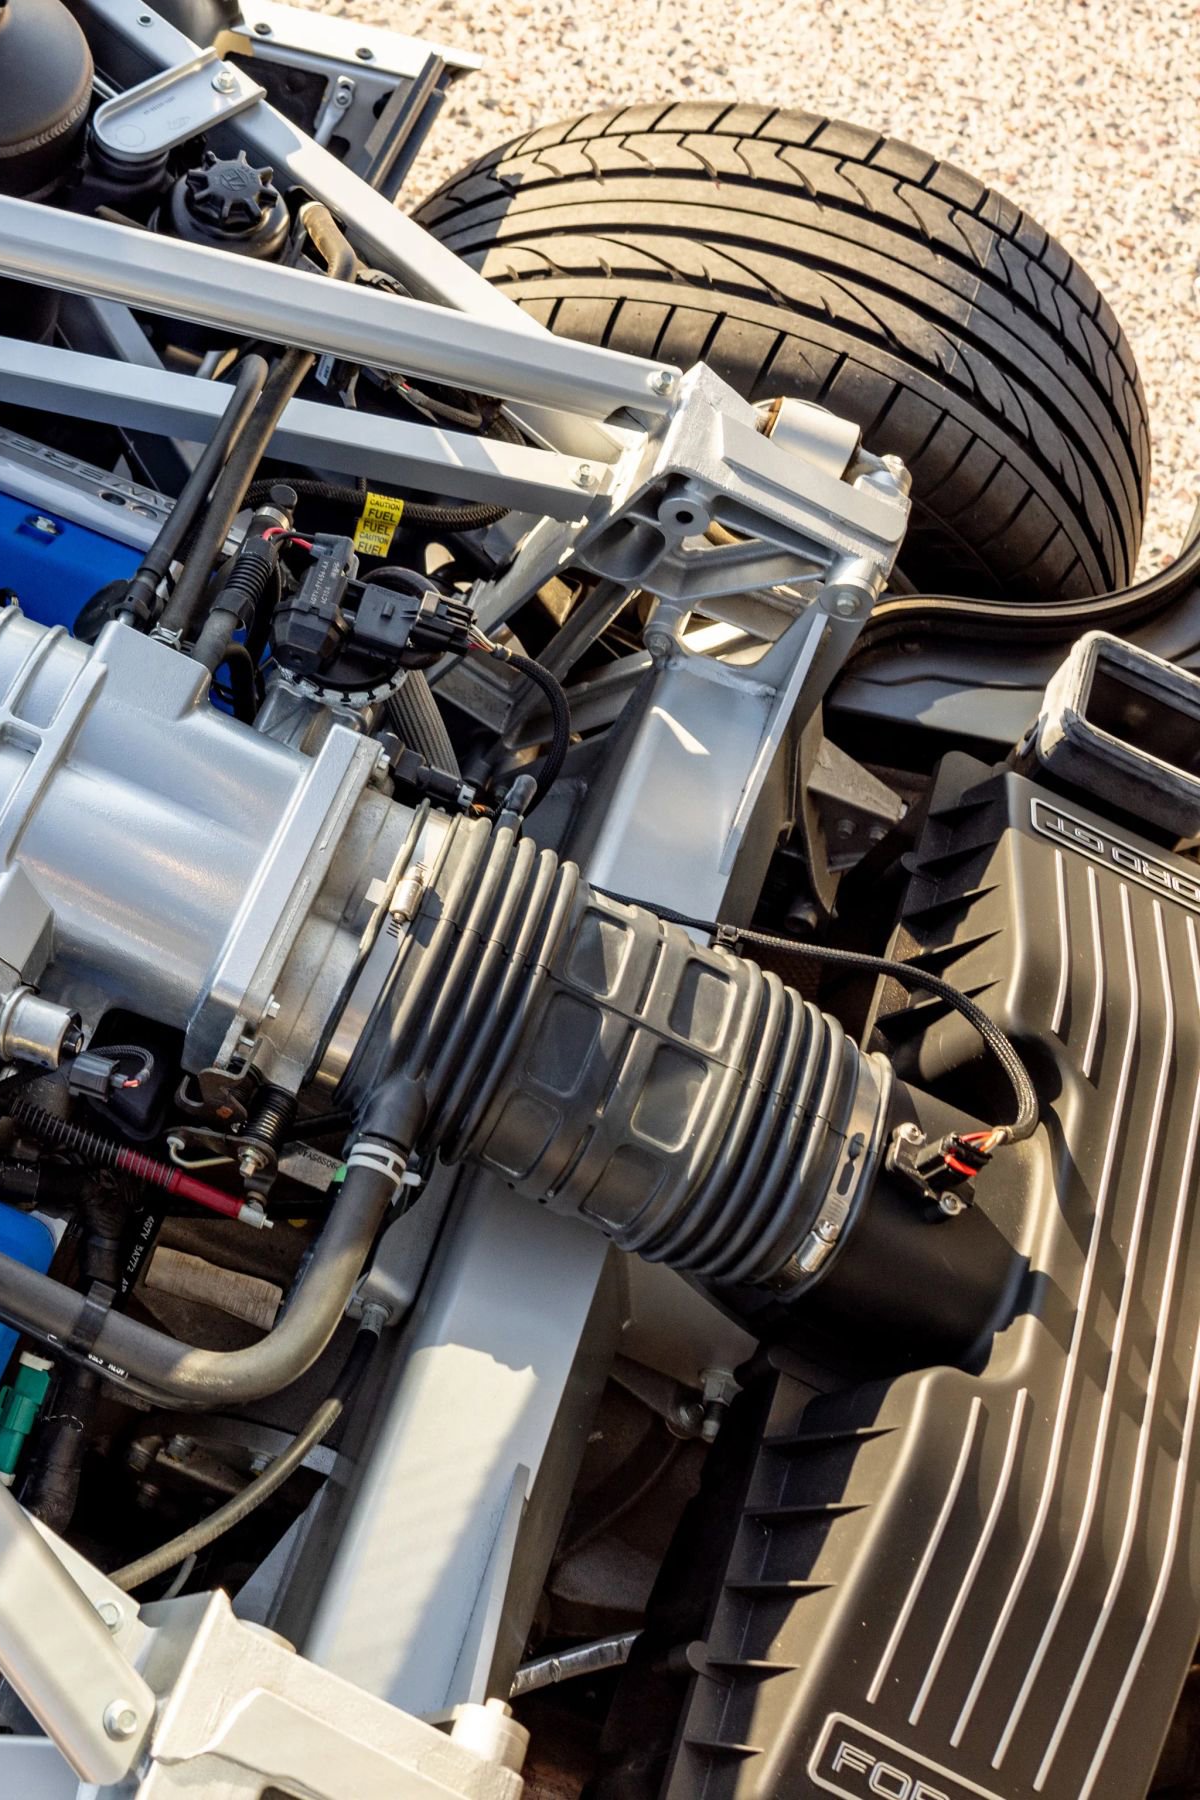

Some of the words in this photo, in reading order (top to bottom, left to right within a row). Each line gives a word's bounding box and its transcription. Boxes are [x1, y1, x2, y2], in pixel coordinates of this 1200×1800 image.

[370, 500, 401, 511] CAUTION
[368, 509, 396, 522] FUEL
[364, 520, 390, 536] FUEL
[1046, 817, 1104, 853] GT
[1111, 847, 1200, 902] ORD
